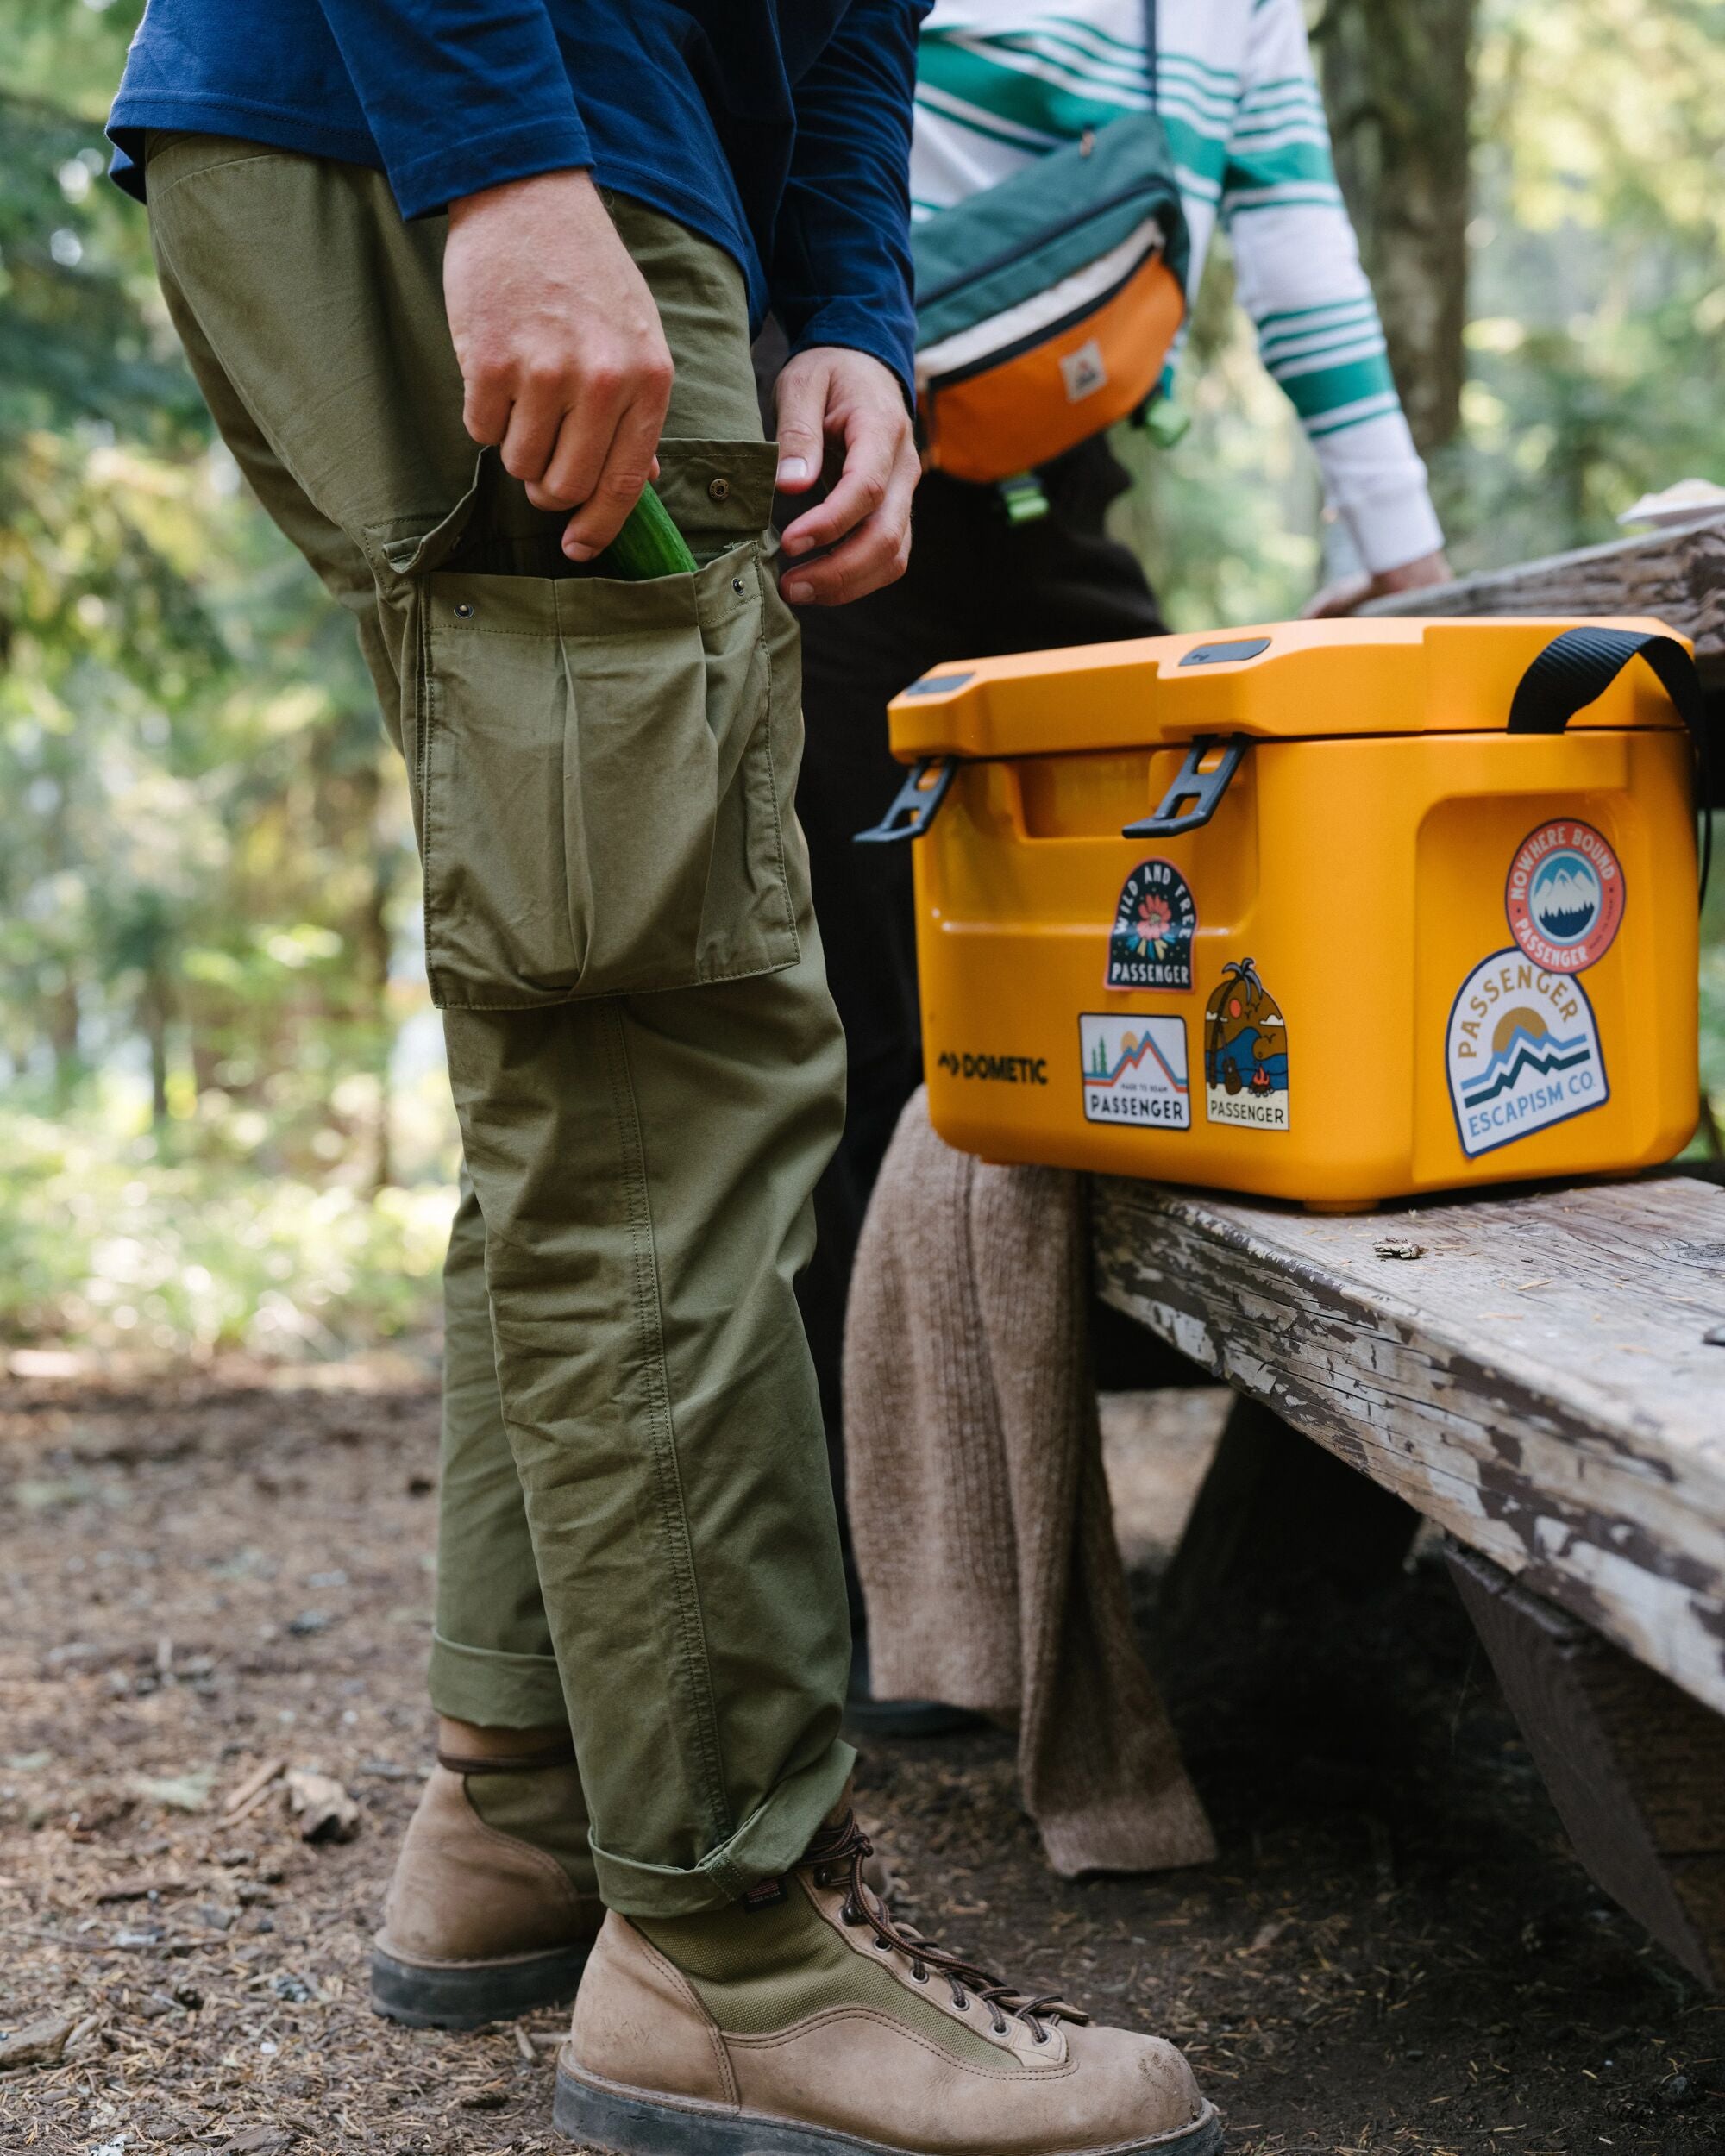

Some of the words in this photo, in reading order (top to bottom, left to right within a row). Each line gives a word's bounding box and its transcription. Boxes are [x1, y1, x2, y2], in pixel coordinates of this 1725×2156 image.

[1511, 826, 1566, 900] NOWHERE
[1571, 828, 1615, 881] BOUND
[1113, 880, 1138, 935] WILD
[1144, 864, 1171, 885] AND
[1175, 883, 1195, 938] FREE
[1515, 917, 1589, 968] PASSENGER
[1111, 962, 1189, 985] PASSENGER
[1458, 964, 1579, 1058] PASSENGER
[963, 1053, 1049, 1085] DOMETIC
[1091, 1094, 1183, 1120] PASSENGER
[1210, 1100, 1283, 1124] PASSENGER
[1468, 1080, 1564, 1138] ESCAPISM
